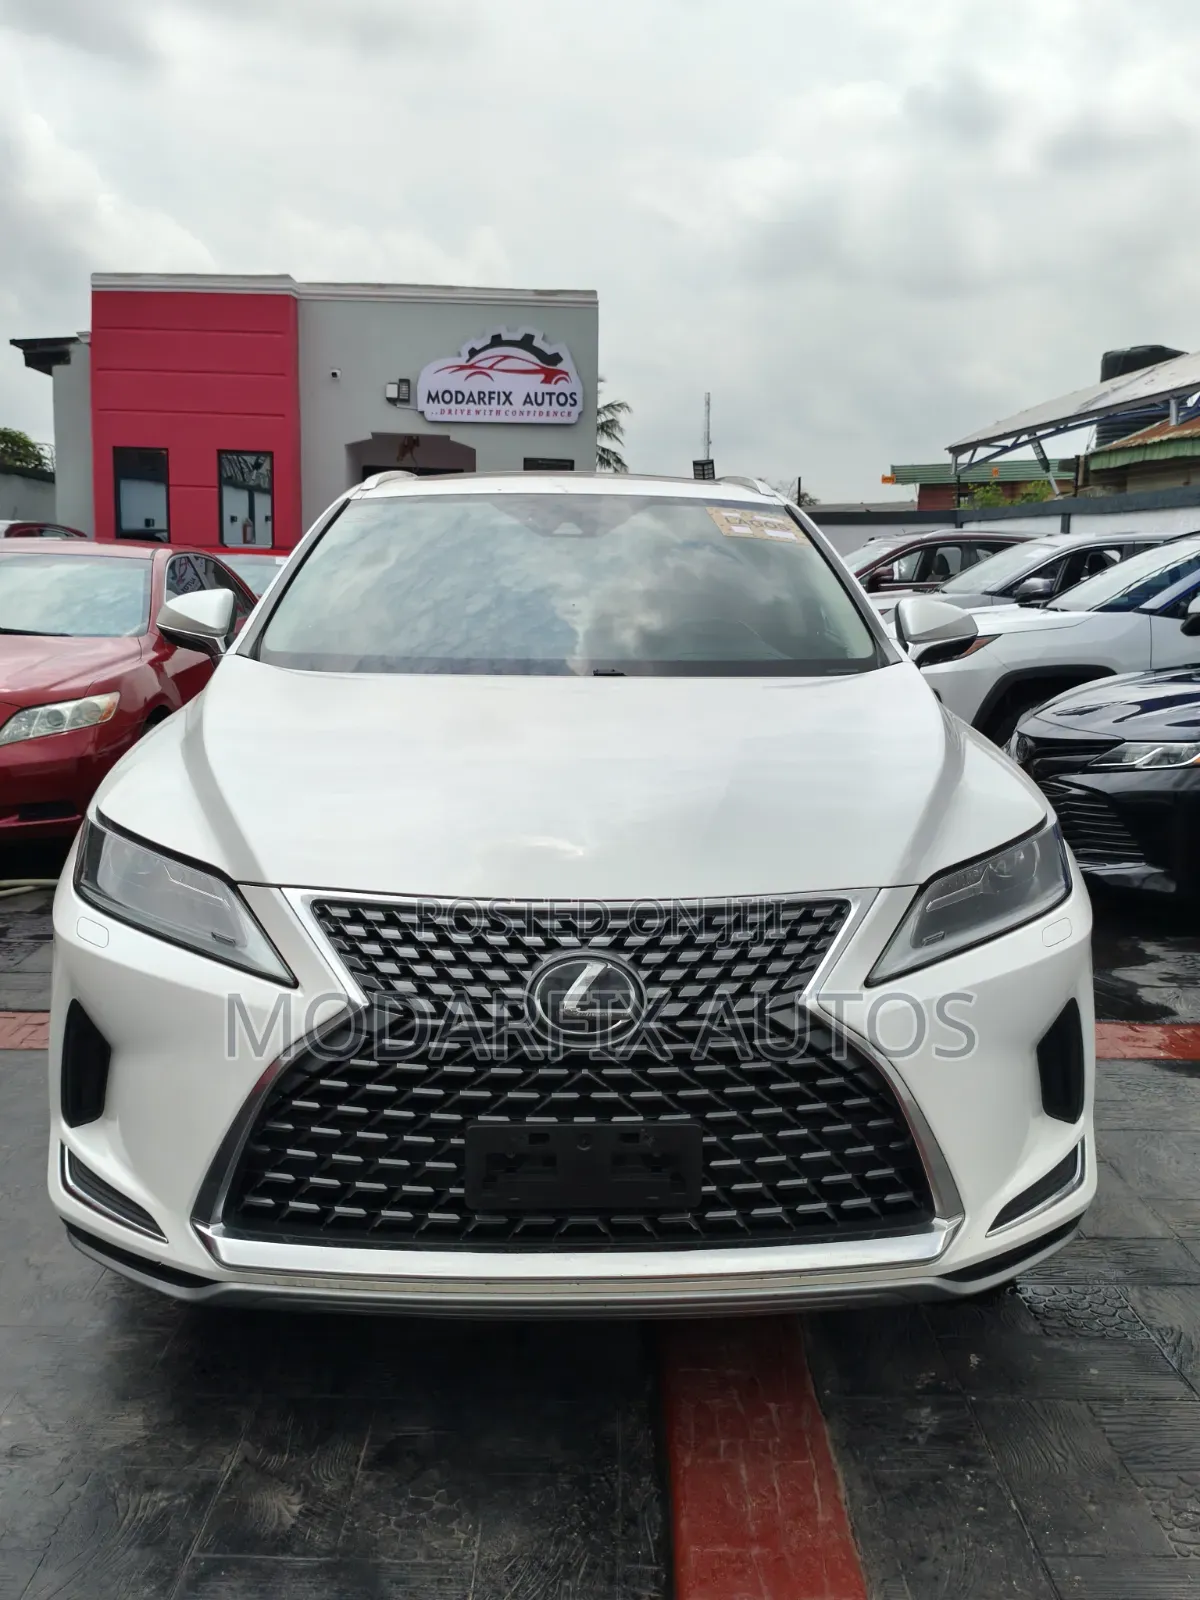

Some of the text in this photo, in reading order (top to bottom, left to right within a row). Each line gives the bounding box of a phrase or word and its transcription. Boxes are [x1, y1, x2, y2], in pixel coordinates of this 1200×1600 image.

[426, 390, 578, 407] MODARFIX AUTOS
[475, 409, 501, 417] WITH
[504, 409, 573, 418] CONFIDENCE
